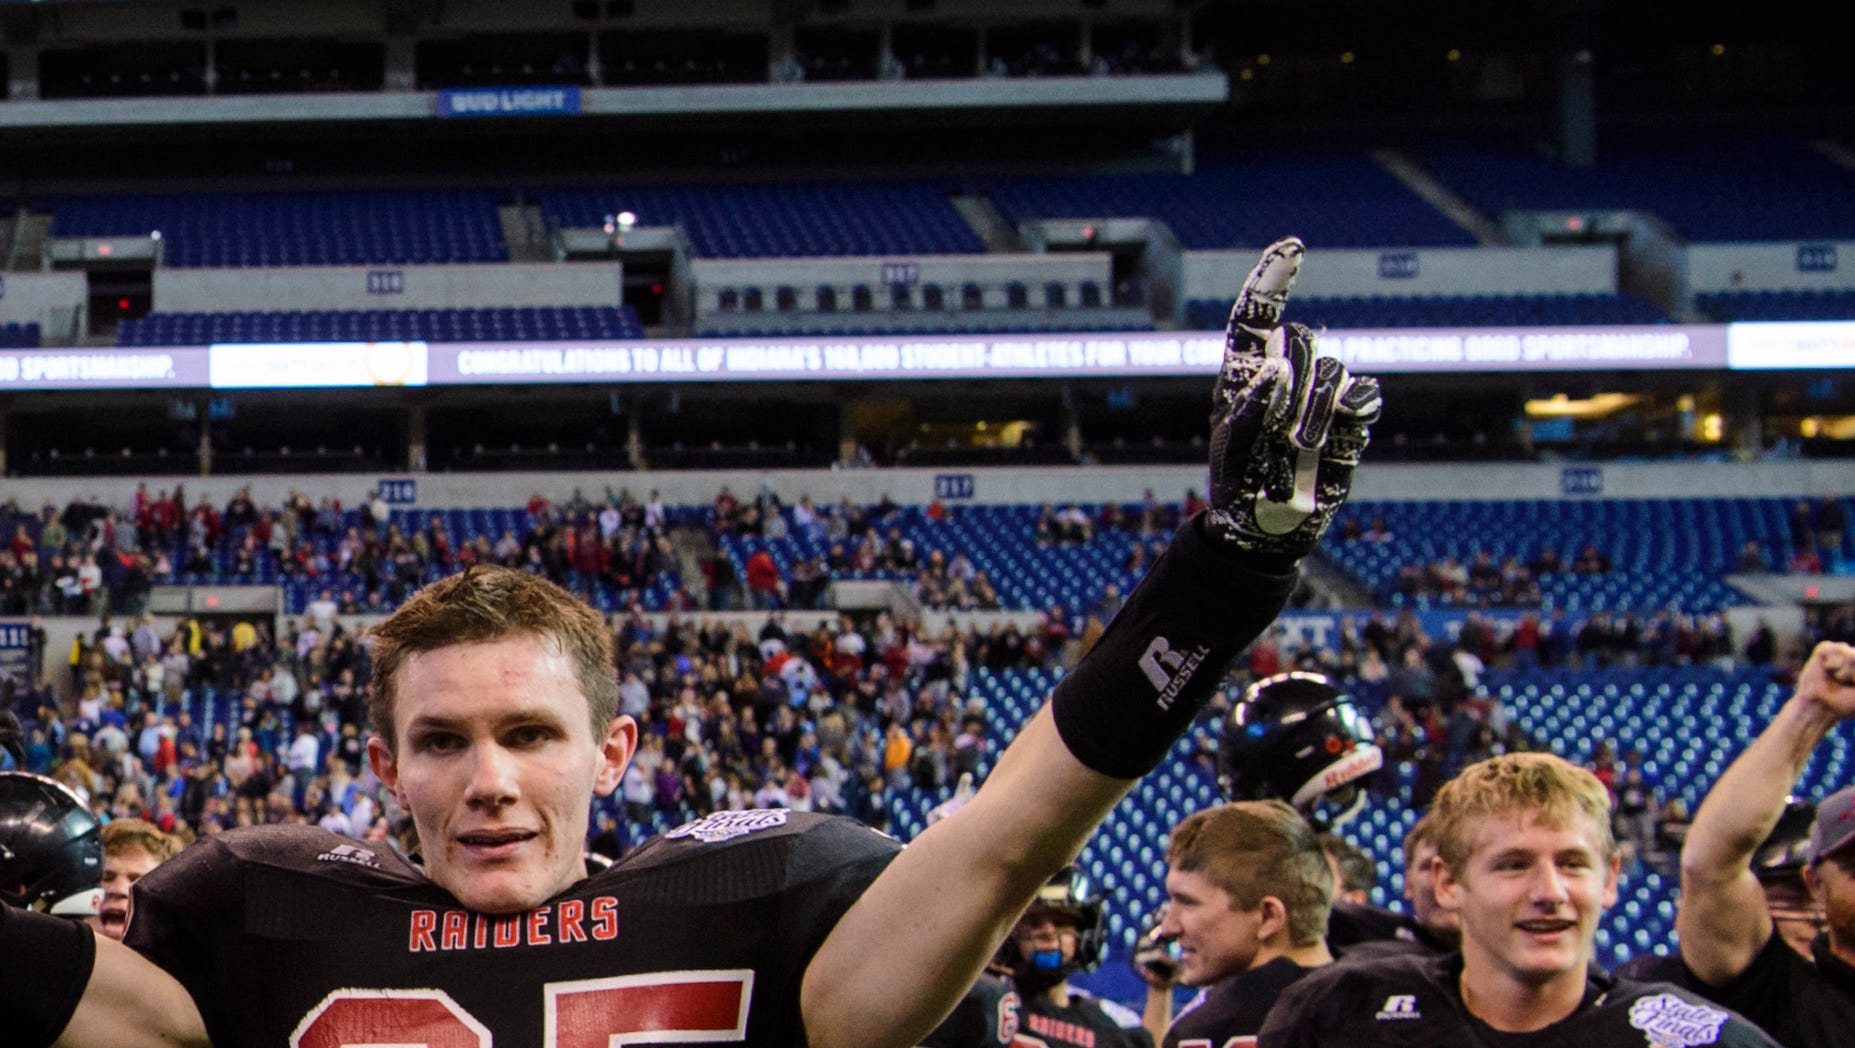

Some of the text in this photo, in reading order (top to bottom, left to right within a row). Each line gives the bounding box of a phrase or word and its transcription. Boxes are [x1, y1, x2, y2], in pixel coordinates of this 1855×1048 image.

[451, 90, 565, 113] BUD LIGHT
[458, 349, 631, 374] CONGRATULATIONS
[632, 348, 658, 371] TO
[661, 348, 695, 371] ALL
[698, 347, 723, 371] OF
[1085, 341, 1126, 366] FOR
[1129, 340, 1182, 365] YOUR
[1282, 616, 1335, 648] XT
[1156, 645, 1211, 711] RUSSELL
[317, 853, 381, 869] RUSSELL
[409, 896, 619, 952] RAIDERS
